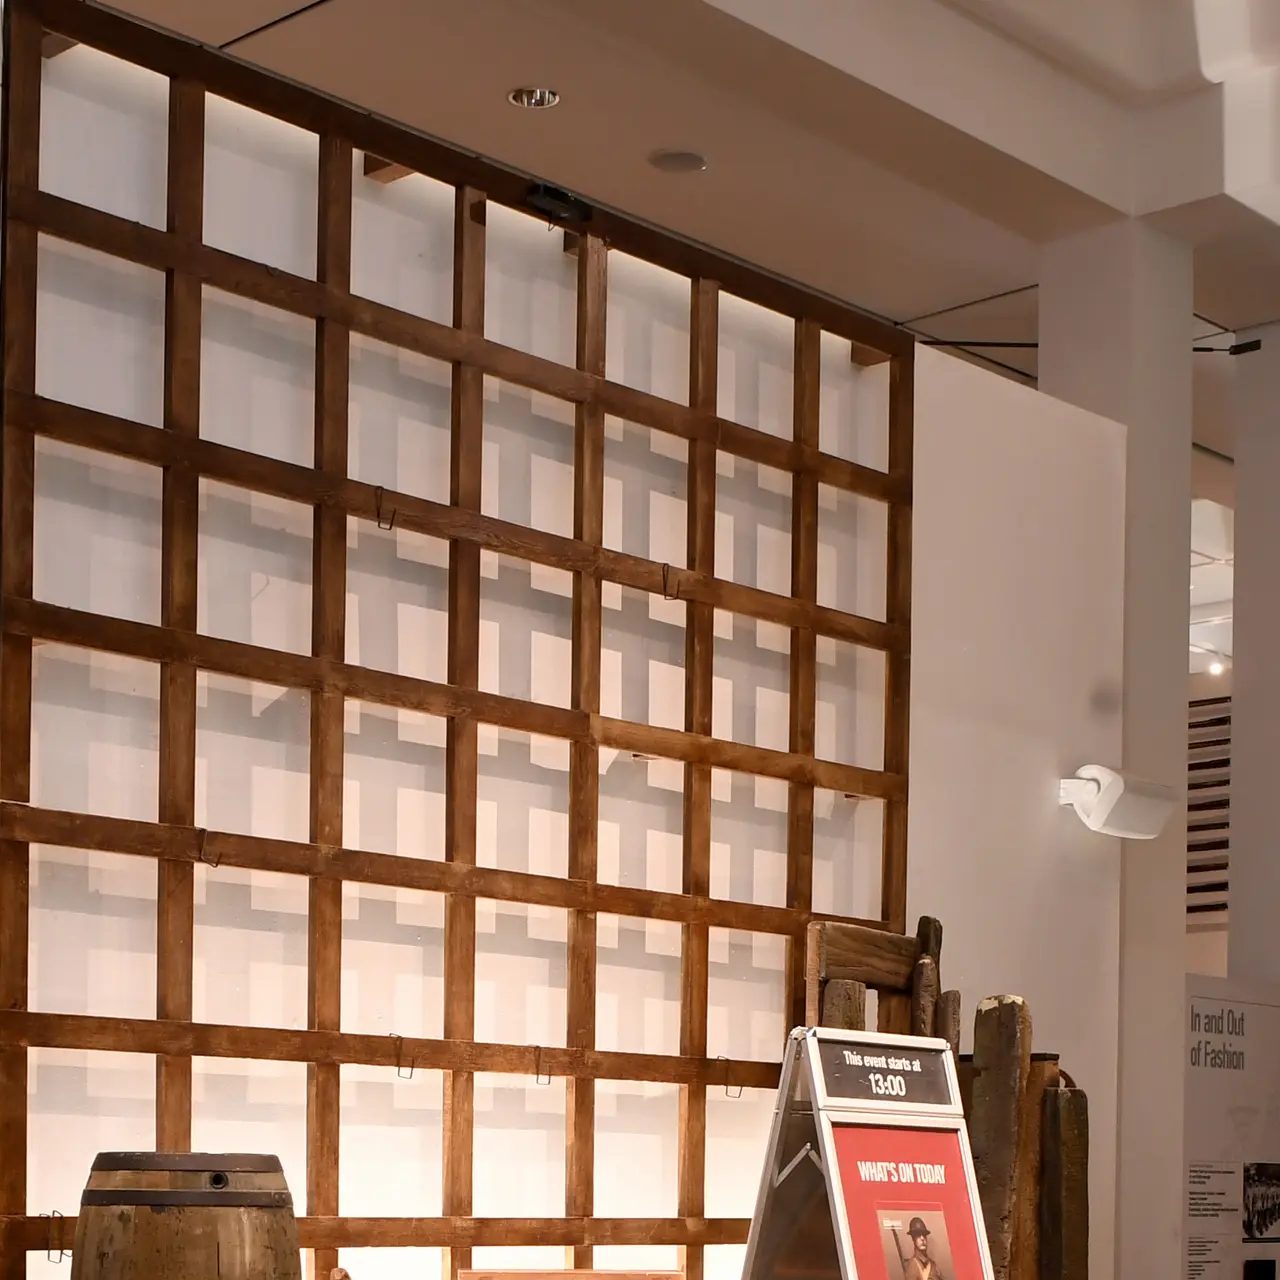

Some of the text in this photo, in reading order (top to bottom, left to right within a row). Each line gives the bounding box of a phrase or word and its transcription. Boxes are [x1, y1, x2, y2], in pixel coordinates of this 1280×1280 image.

[1191, 1004, 1244, 1036] In and Out
[843, 1050, 922, 1072] This event starts at
[1191, 1040, 1244, 1070] of Fashion
[869, 1073, 906, 1097] 13:00
[857, 1161, 945, 1184] WHAT'S ON TODAY
